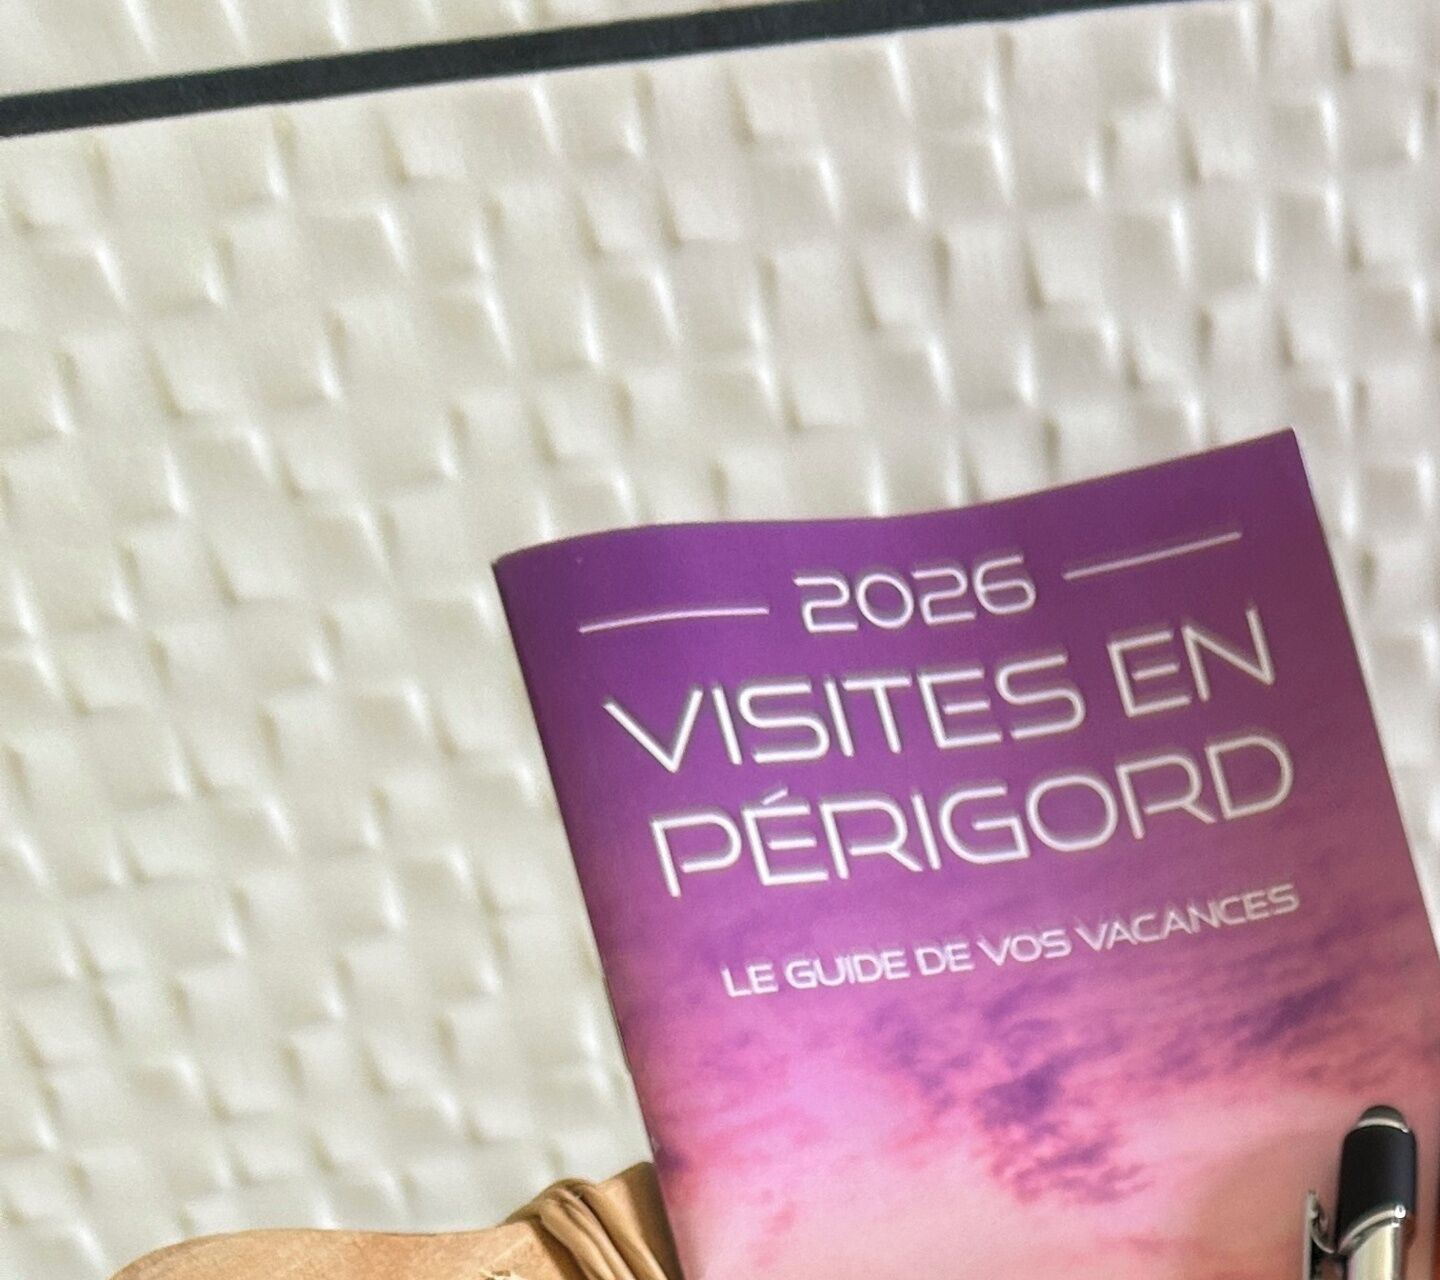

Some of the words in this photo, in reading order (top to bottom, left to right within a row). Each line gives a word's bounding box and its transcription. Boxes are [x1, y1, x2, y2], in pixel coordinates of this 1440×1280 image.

[793, 552, 1037, 634] 2026
[603, 651, 1087, 774] VISITES
[1108, 606, 1278, 718] EN
[650, 733, 1296, 897] PÉRIGORD
[721, 963, 778, 998] LE
[786, 948, 909, 992] GUIDE
[918, 939, 976, 978] DE
[978, 928, 1073, 970] VOS
[1075, 883, 1300, 955] VACANCES
